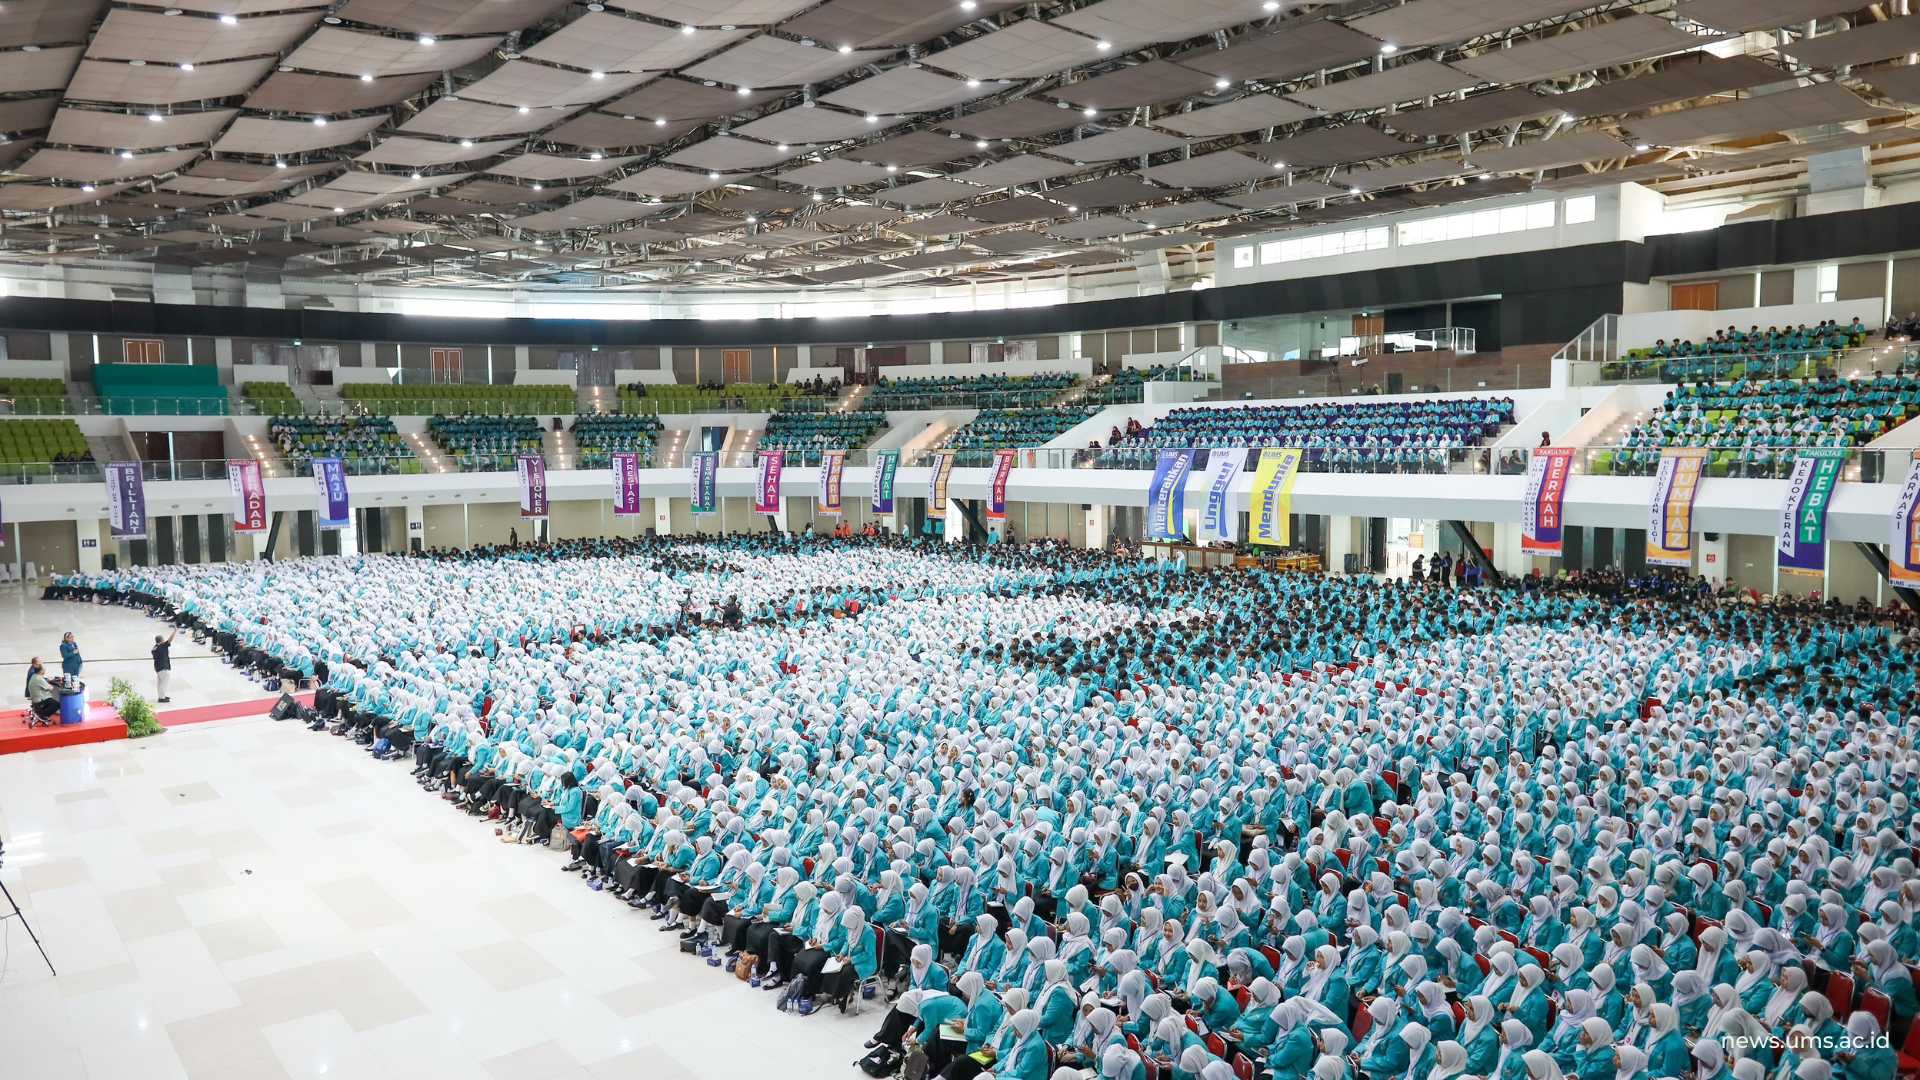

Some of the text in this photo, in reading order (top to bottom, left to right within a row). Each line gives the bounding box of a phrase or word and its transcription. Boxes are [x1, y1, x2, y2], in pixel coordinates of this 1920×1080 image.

[125, 468, 139, 533] BRILLIANT
[328, 464, 342, 501] MAJU
[626, 458, 635, 511] PRESTASI
[767, 457, 778, 504] SEHAT
[883, 456, 895, 499] HEBAT
[996, 456, 1010, 503] BERKAH
[1154, 454, 1188, 533] Mencerahkan
[1205, 462, 1234, 530] Unggul
[1258, 454, 1295, 539] Mendunia
[1543, 457, 1564, 528] BERKAH
[1671, 460, 1698, 547] MUMTAZ
[1782, 460, 1809, 549] KEDOKTERAN
[1804, 459, 1836, 542] HEBAT
